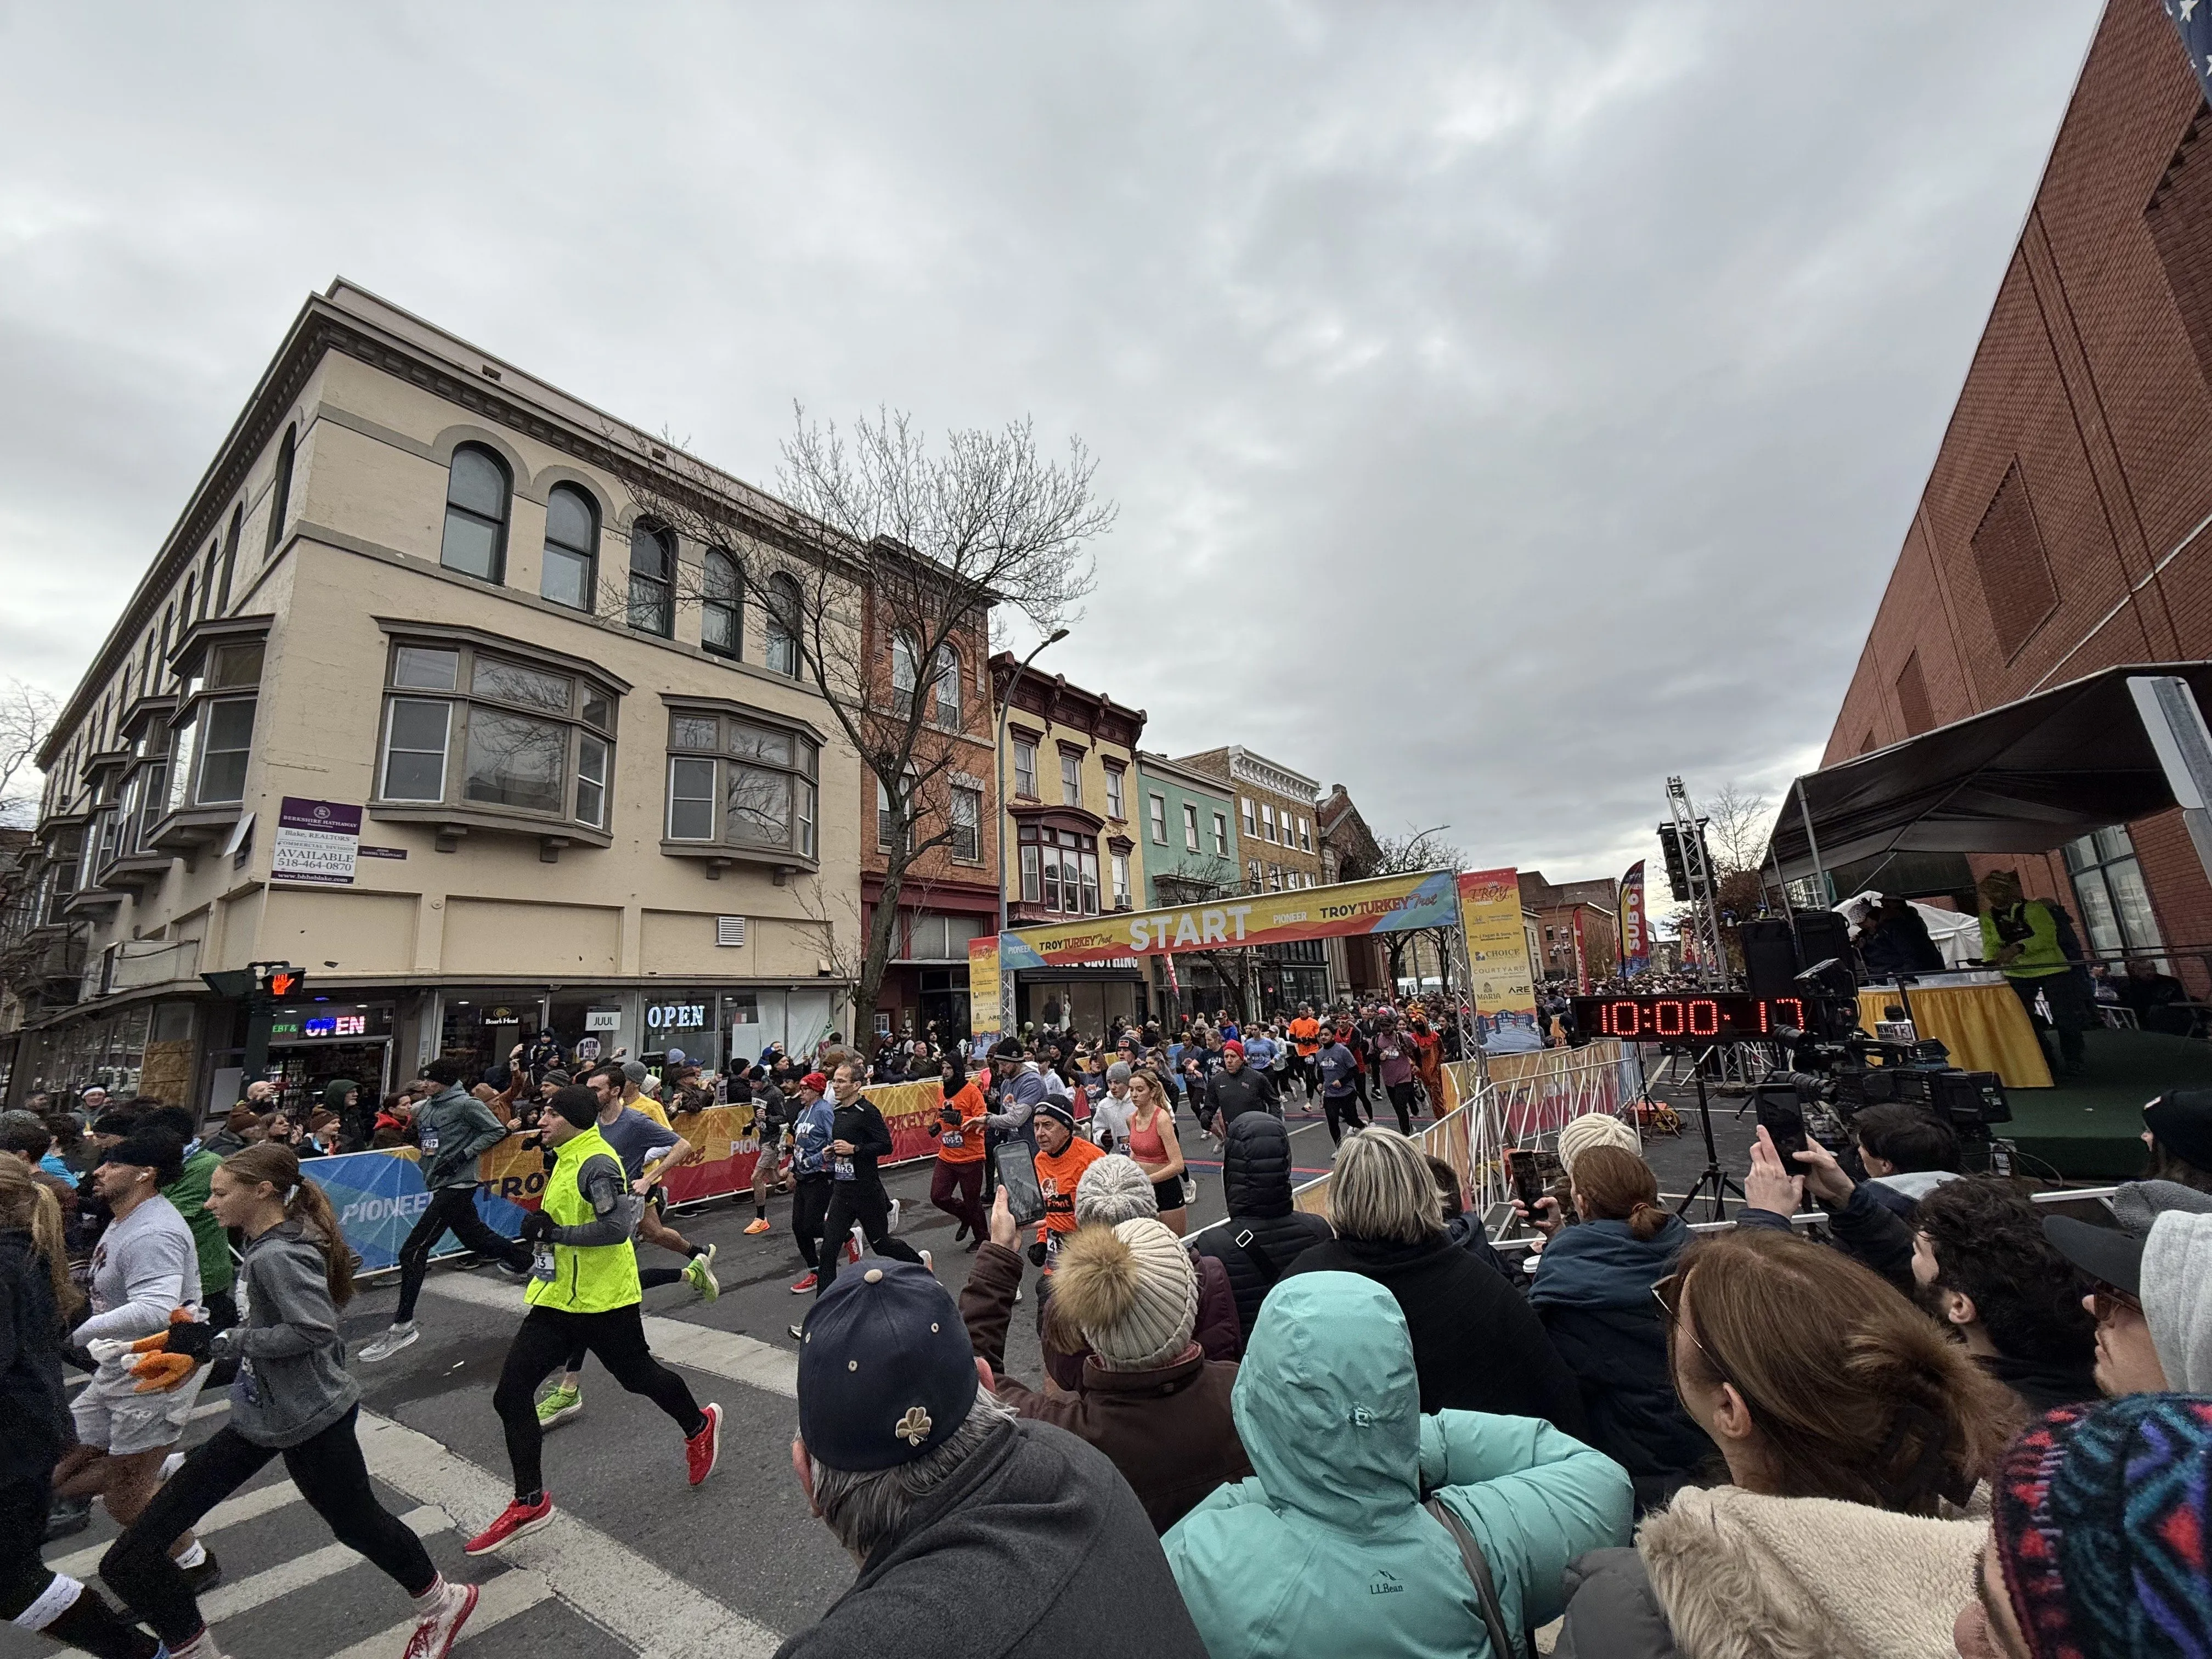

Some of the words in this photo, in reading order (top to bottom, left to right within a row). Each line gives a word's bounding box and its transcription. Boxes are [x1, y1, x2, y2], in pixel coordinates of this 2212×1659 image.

[283, 815, 322, 823] BERKSHIRE
[309, 833, 350, 842] REALTORS
[276, 849, 354, 863] AVAILABLE
[278, 858, 352, 871] 518-464-0870
[1469, 885, 1509, 902] TROY
[1319, 904, 1357, 919] TROY
[1358, 896, 1409, 915] TURKEY
[1408, 894, 1437, 909] Trot
[1273, 911, 1307, 924] PIONEER
[1130, 905, 1252, 951] START
[1039, 940, 1063, 951] TROY
[1063, 935, 1097, 949] TURKEY
[1096, 934, 1113, 945] Trot
[1008, 945, 1031, 955] PIONEER
[1486, 949, 1520, 957] CHOICE
[1474, 966, 1525, 974] COURTYARD
[1509, 986, 1531, 994] ARE
[593, 1017, 613, 1026] JUUL
[648, 1006, 705, 1028] OPEN
[305, 1016, 365, 1036] OPEN
[1894, 1025, 1912, 1039] 13
[585, 1041, 597, 1049] ATM
[730, 1138, 760, 1155] PION
[478, 1172, 544, 1201] TRO
[338, 1192, 433, 1225] PIONEE
